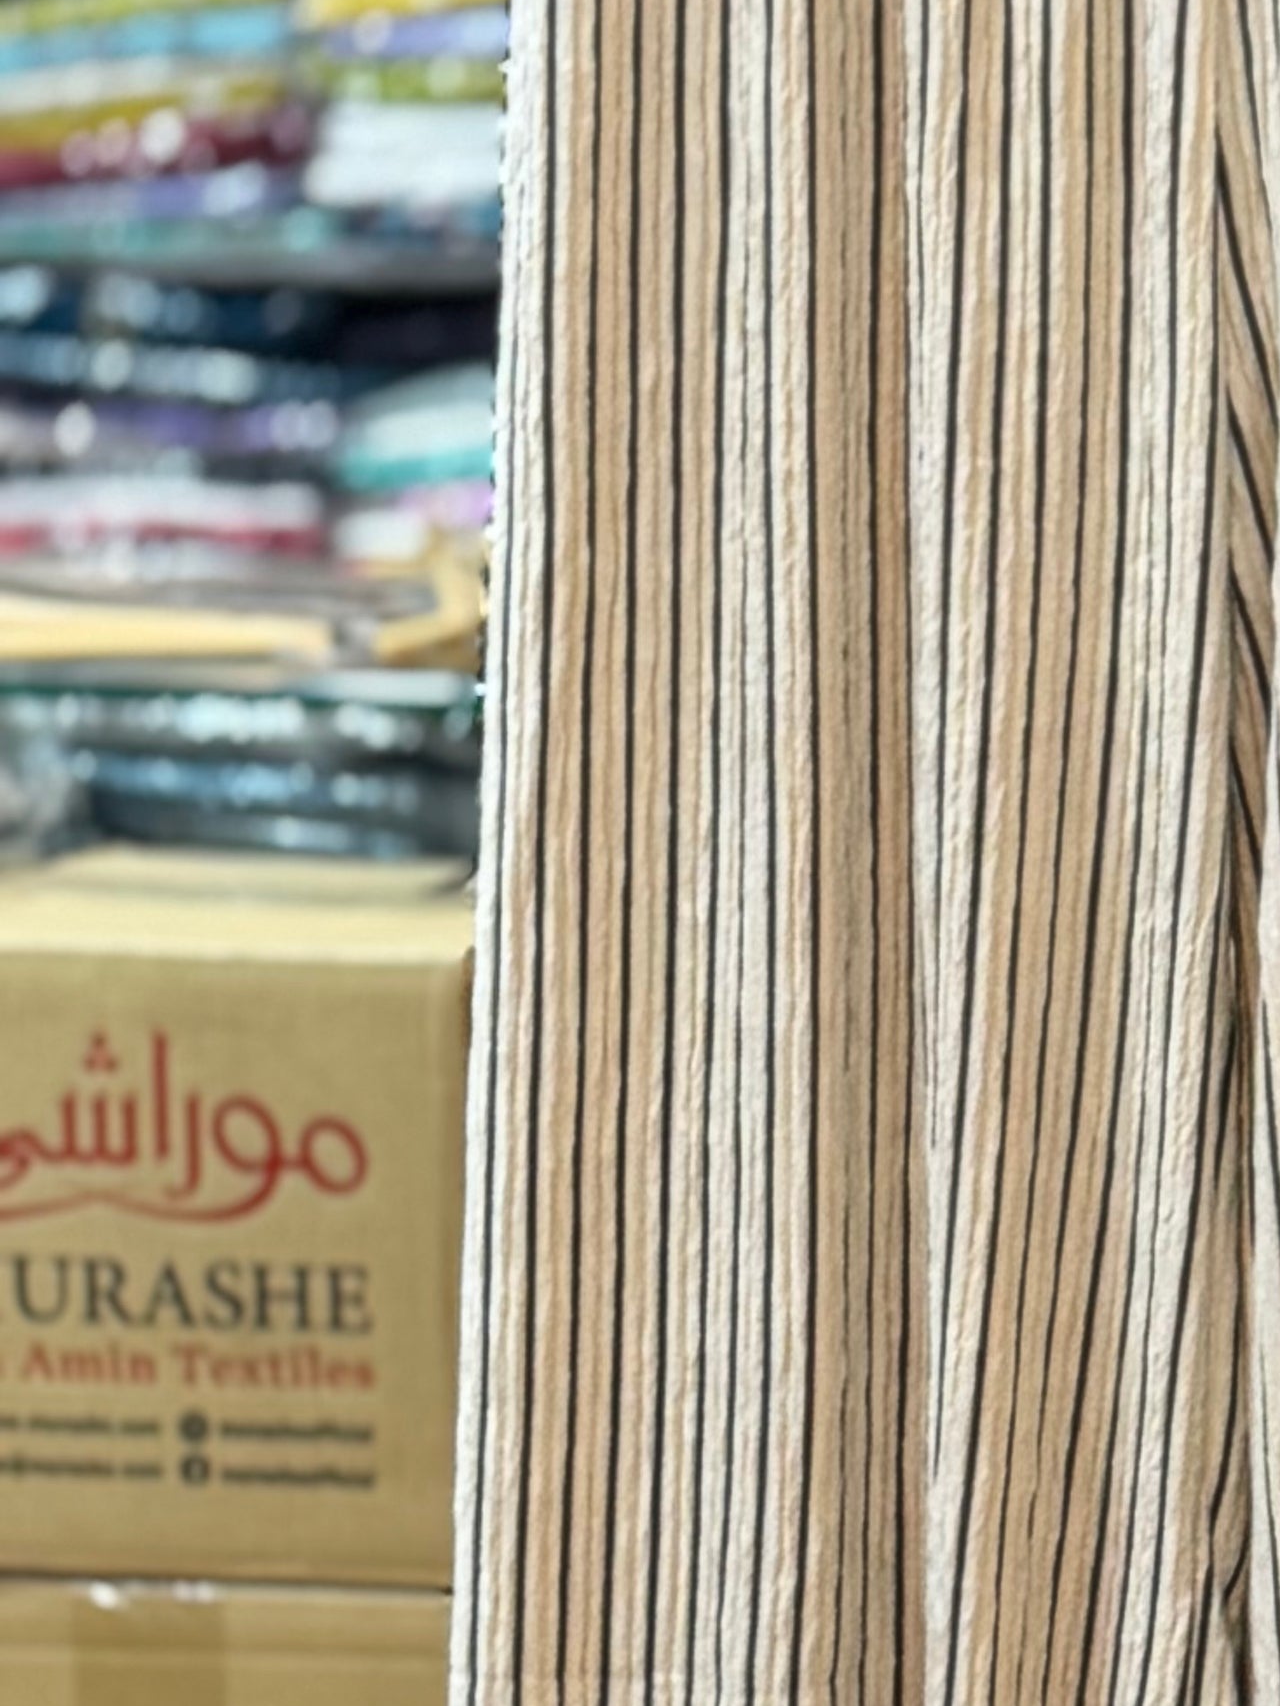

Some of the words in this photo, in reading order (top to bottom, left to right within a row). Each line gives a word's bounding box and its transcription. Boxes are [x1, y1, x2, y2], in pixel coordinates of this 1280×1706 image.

[10, 1253, 374, 1336] URASHE
[20, 1341, 158, 1387] Amin
[172, 1343, 378, 1391] Textiles
